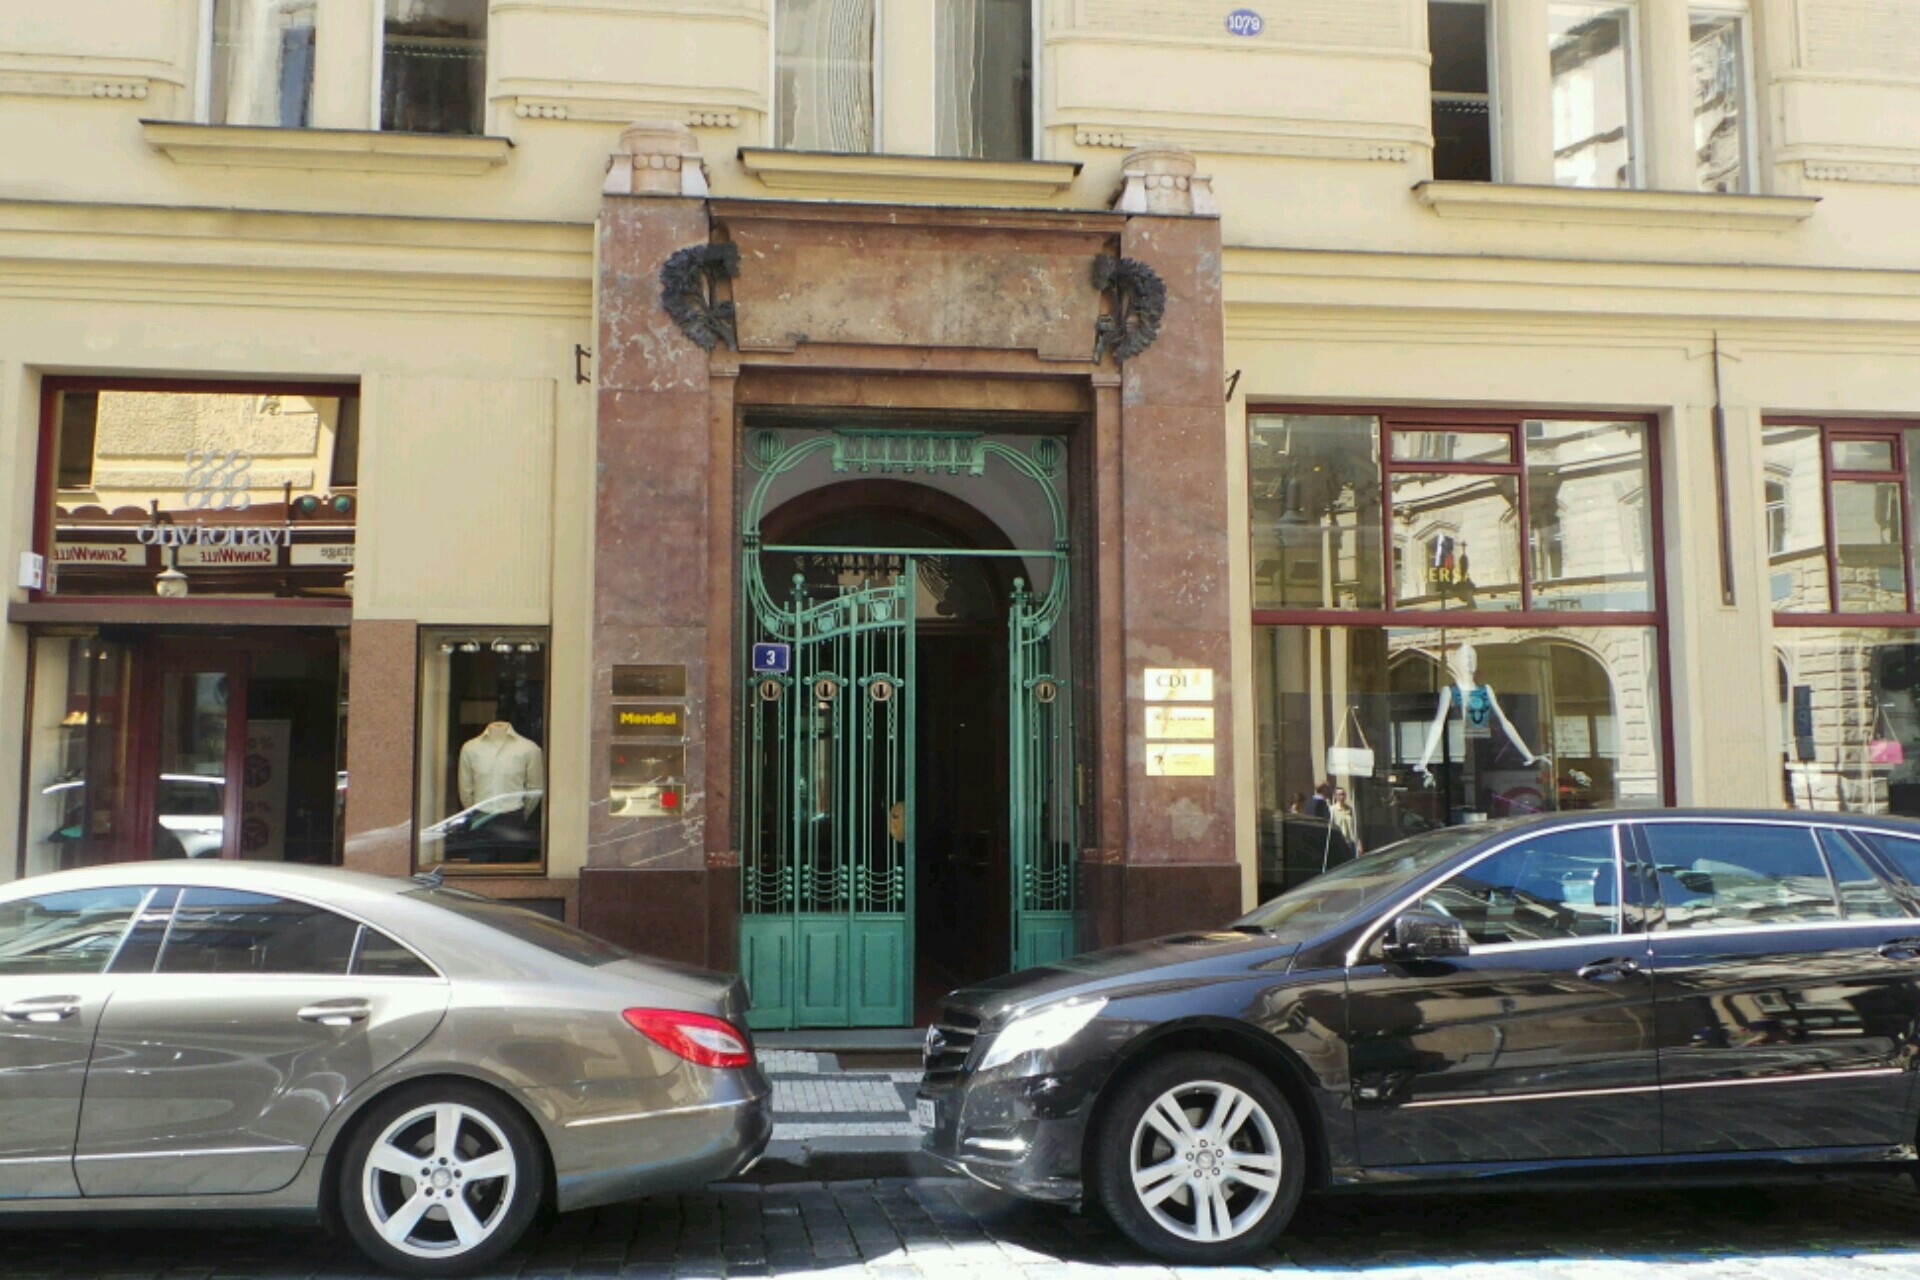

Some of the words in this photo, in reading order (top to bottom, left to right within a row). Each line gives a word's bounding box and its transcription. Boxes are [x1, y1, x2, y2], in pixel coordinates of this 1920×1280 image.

[1229, 15, 1260, 35] 1079
[766, 650, 775, 665] 3
[1157, 673, 1187, 688] CDI
